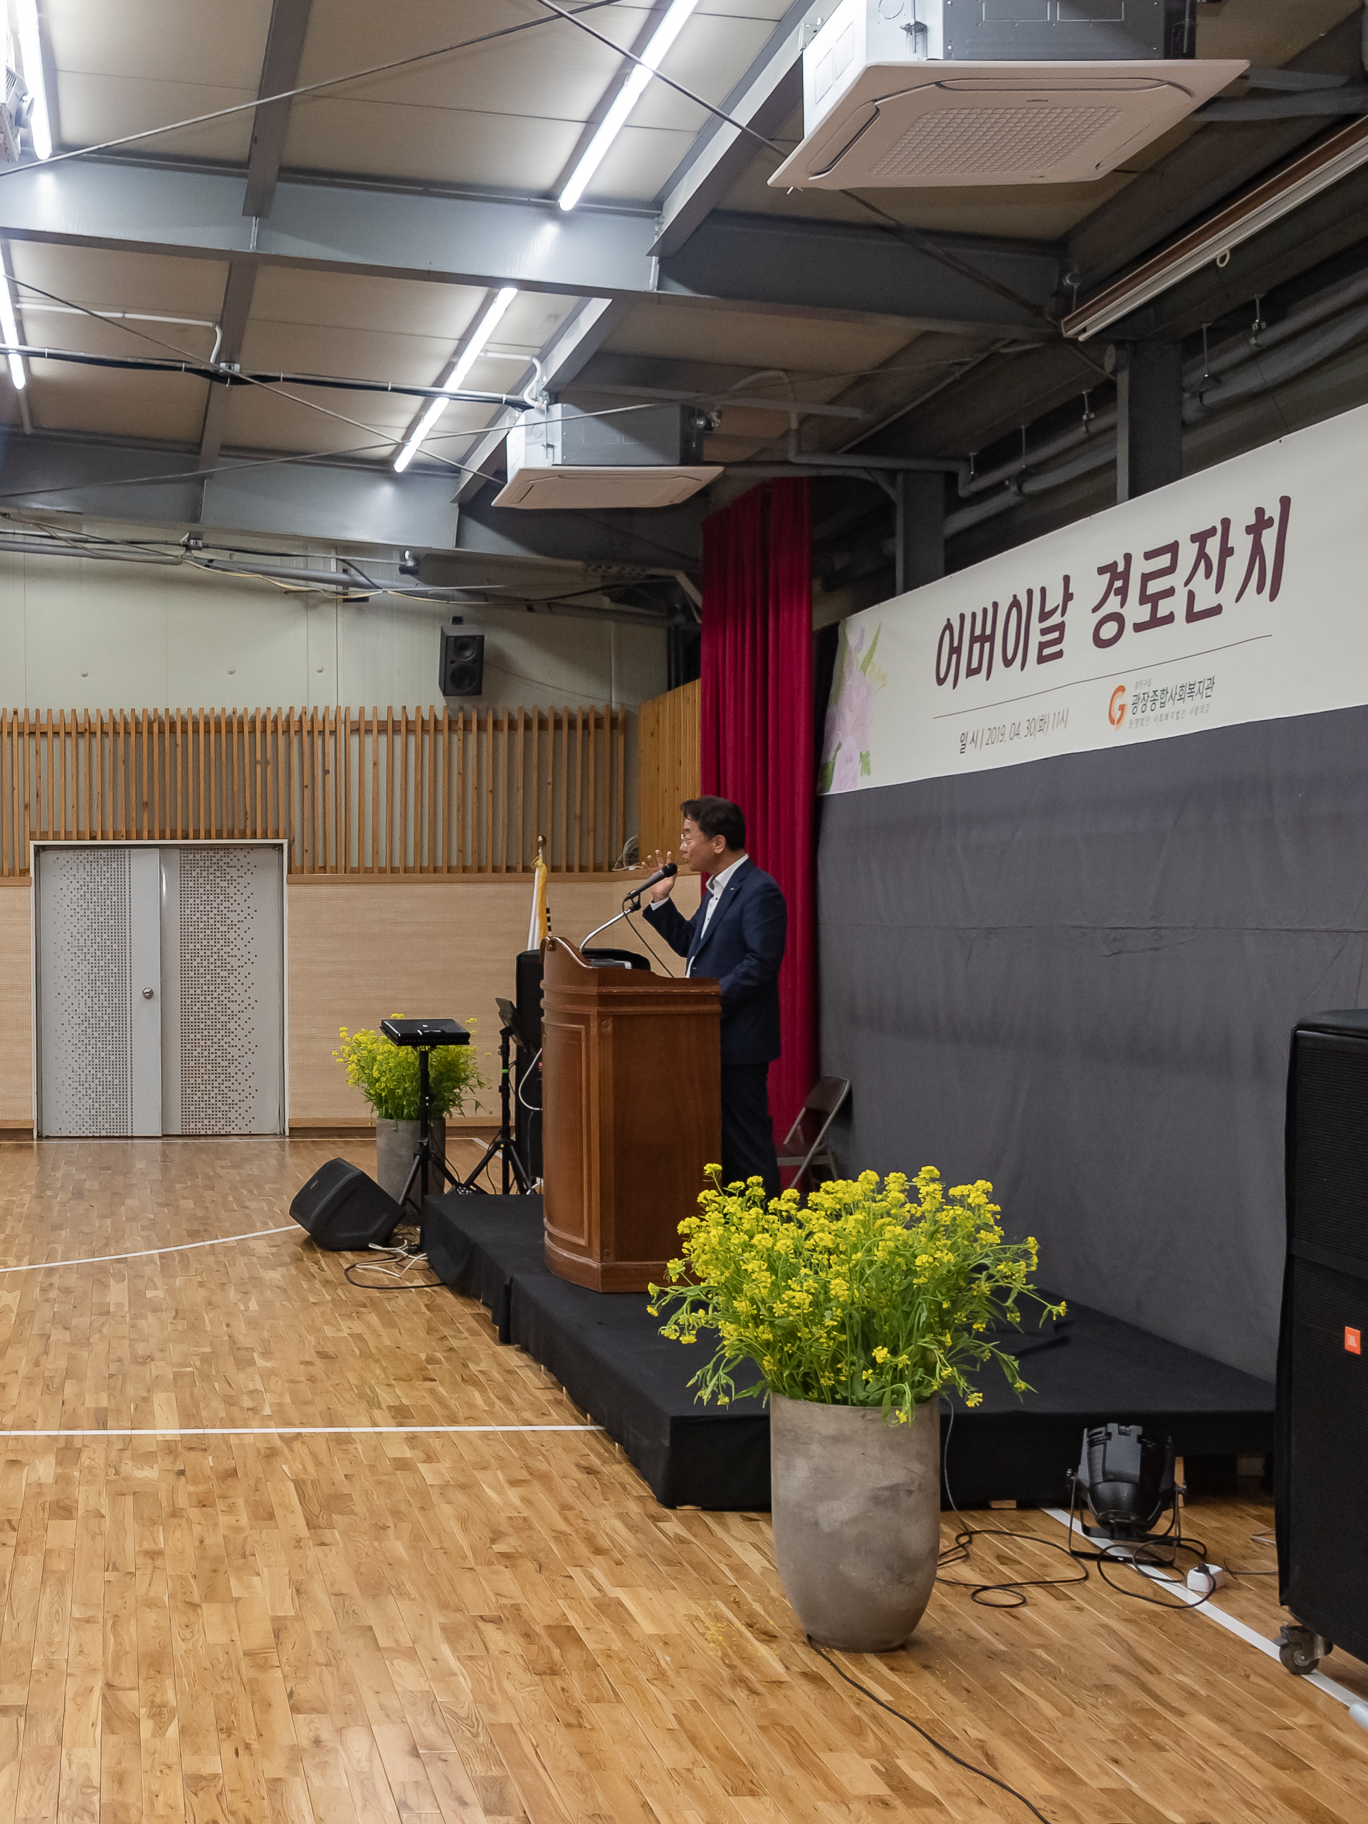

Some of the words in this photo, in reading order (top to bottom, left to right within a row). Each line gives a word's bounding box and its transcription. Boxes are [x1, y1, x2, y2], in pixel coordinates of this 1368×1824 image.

[935, 574, 1074, 690] 어버이날
[1091, 495, 1291, 649] 경로잔치
[1131, 675, 1215, 715] 광장종합사회복지관
